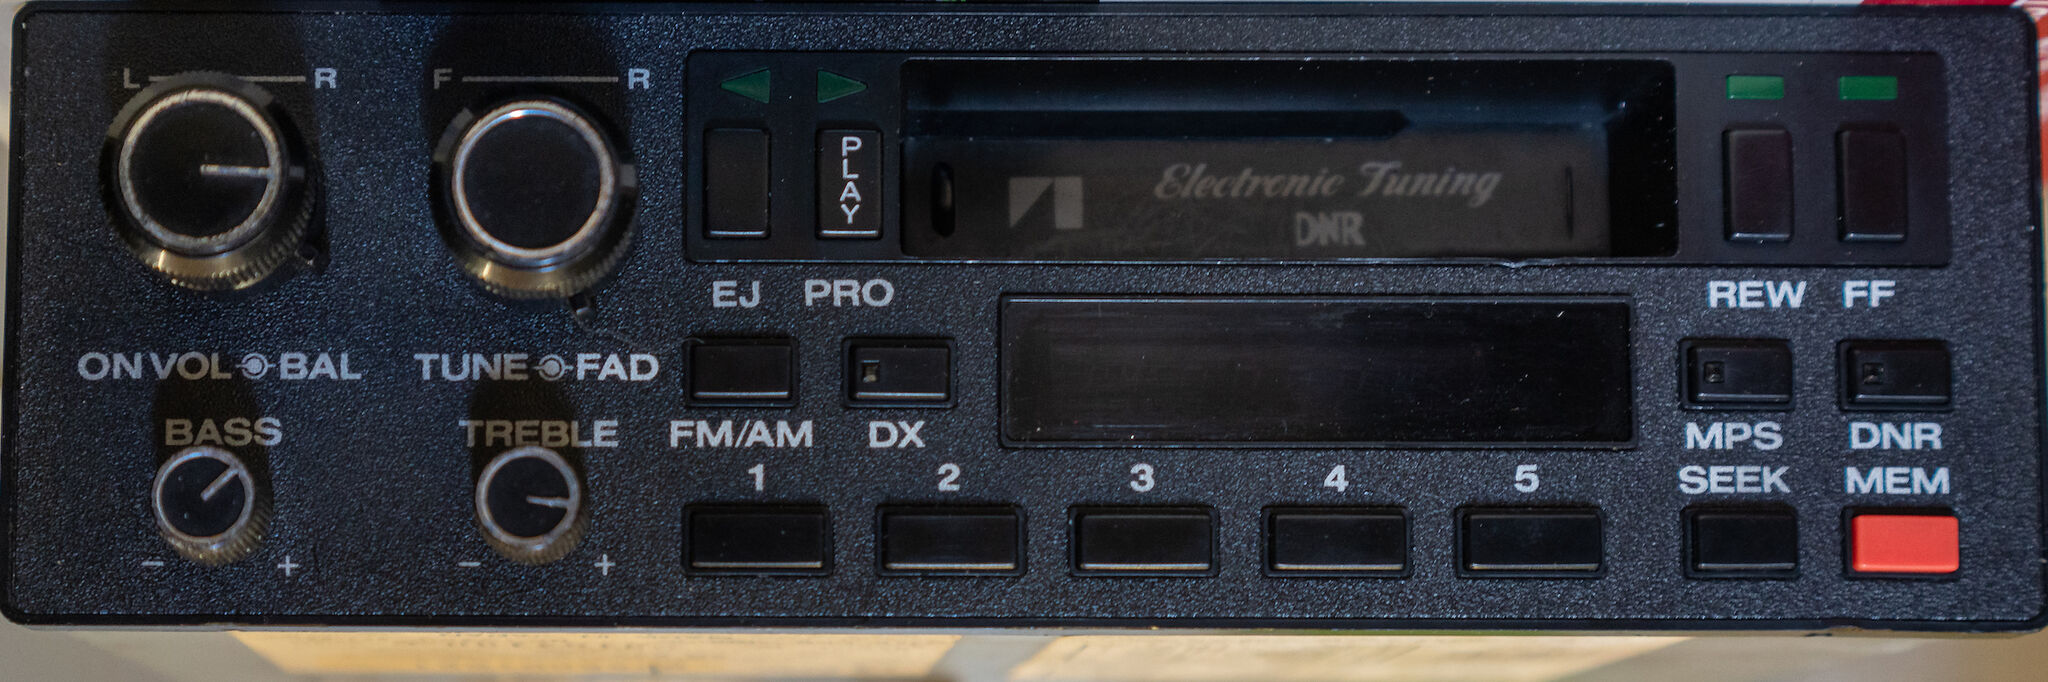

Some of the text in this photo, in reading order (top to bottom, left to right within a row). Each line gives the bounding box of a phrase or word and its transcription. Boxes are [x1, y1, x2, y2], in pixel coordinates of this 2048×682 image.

[124, 69, 140, 88] L
[315, 69, 337, 88] R
[434, 70, 452, 89] F
[628, 69, 650, 88] R
[840, 136, 863, 224] PLAY
[1154, 164, 1340, 198] Electronic
[1359, 161, 1503, 207] Tuning
[712, 281, 761, 307] EJ
[804, 279, 895, 306] PRO
[1708, 280, 1807, 308] REW
[1843, 280, 1896, 308] FF
[79, 353, 361, 380] ON VOL BAL
[414, 353, 659, 381] TUNE FAD
[165, 418, 282, 446] BASS
[459, 421, 618, 447] TREBLE
[670, 421, 813, 448] FM/AM
[869, 421, 926, 448] DX
[1685, 421, 1784, 450] MPS
[1849, 422, 1943, 450] DNR
[748, 464, 765, 491] 1
[937, 463, 961, 491] 2
[1130, 463, 1155, 492] 3
[1324, 464, 1349, 492] 4
[1515, 464, 1540, 492] 5
[1678, 466, 1790, 494] SEEK
[1845, 467, 1950, 494] MEM
